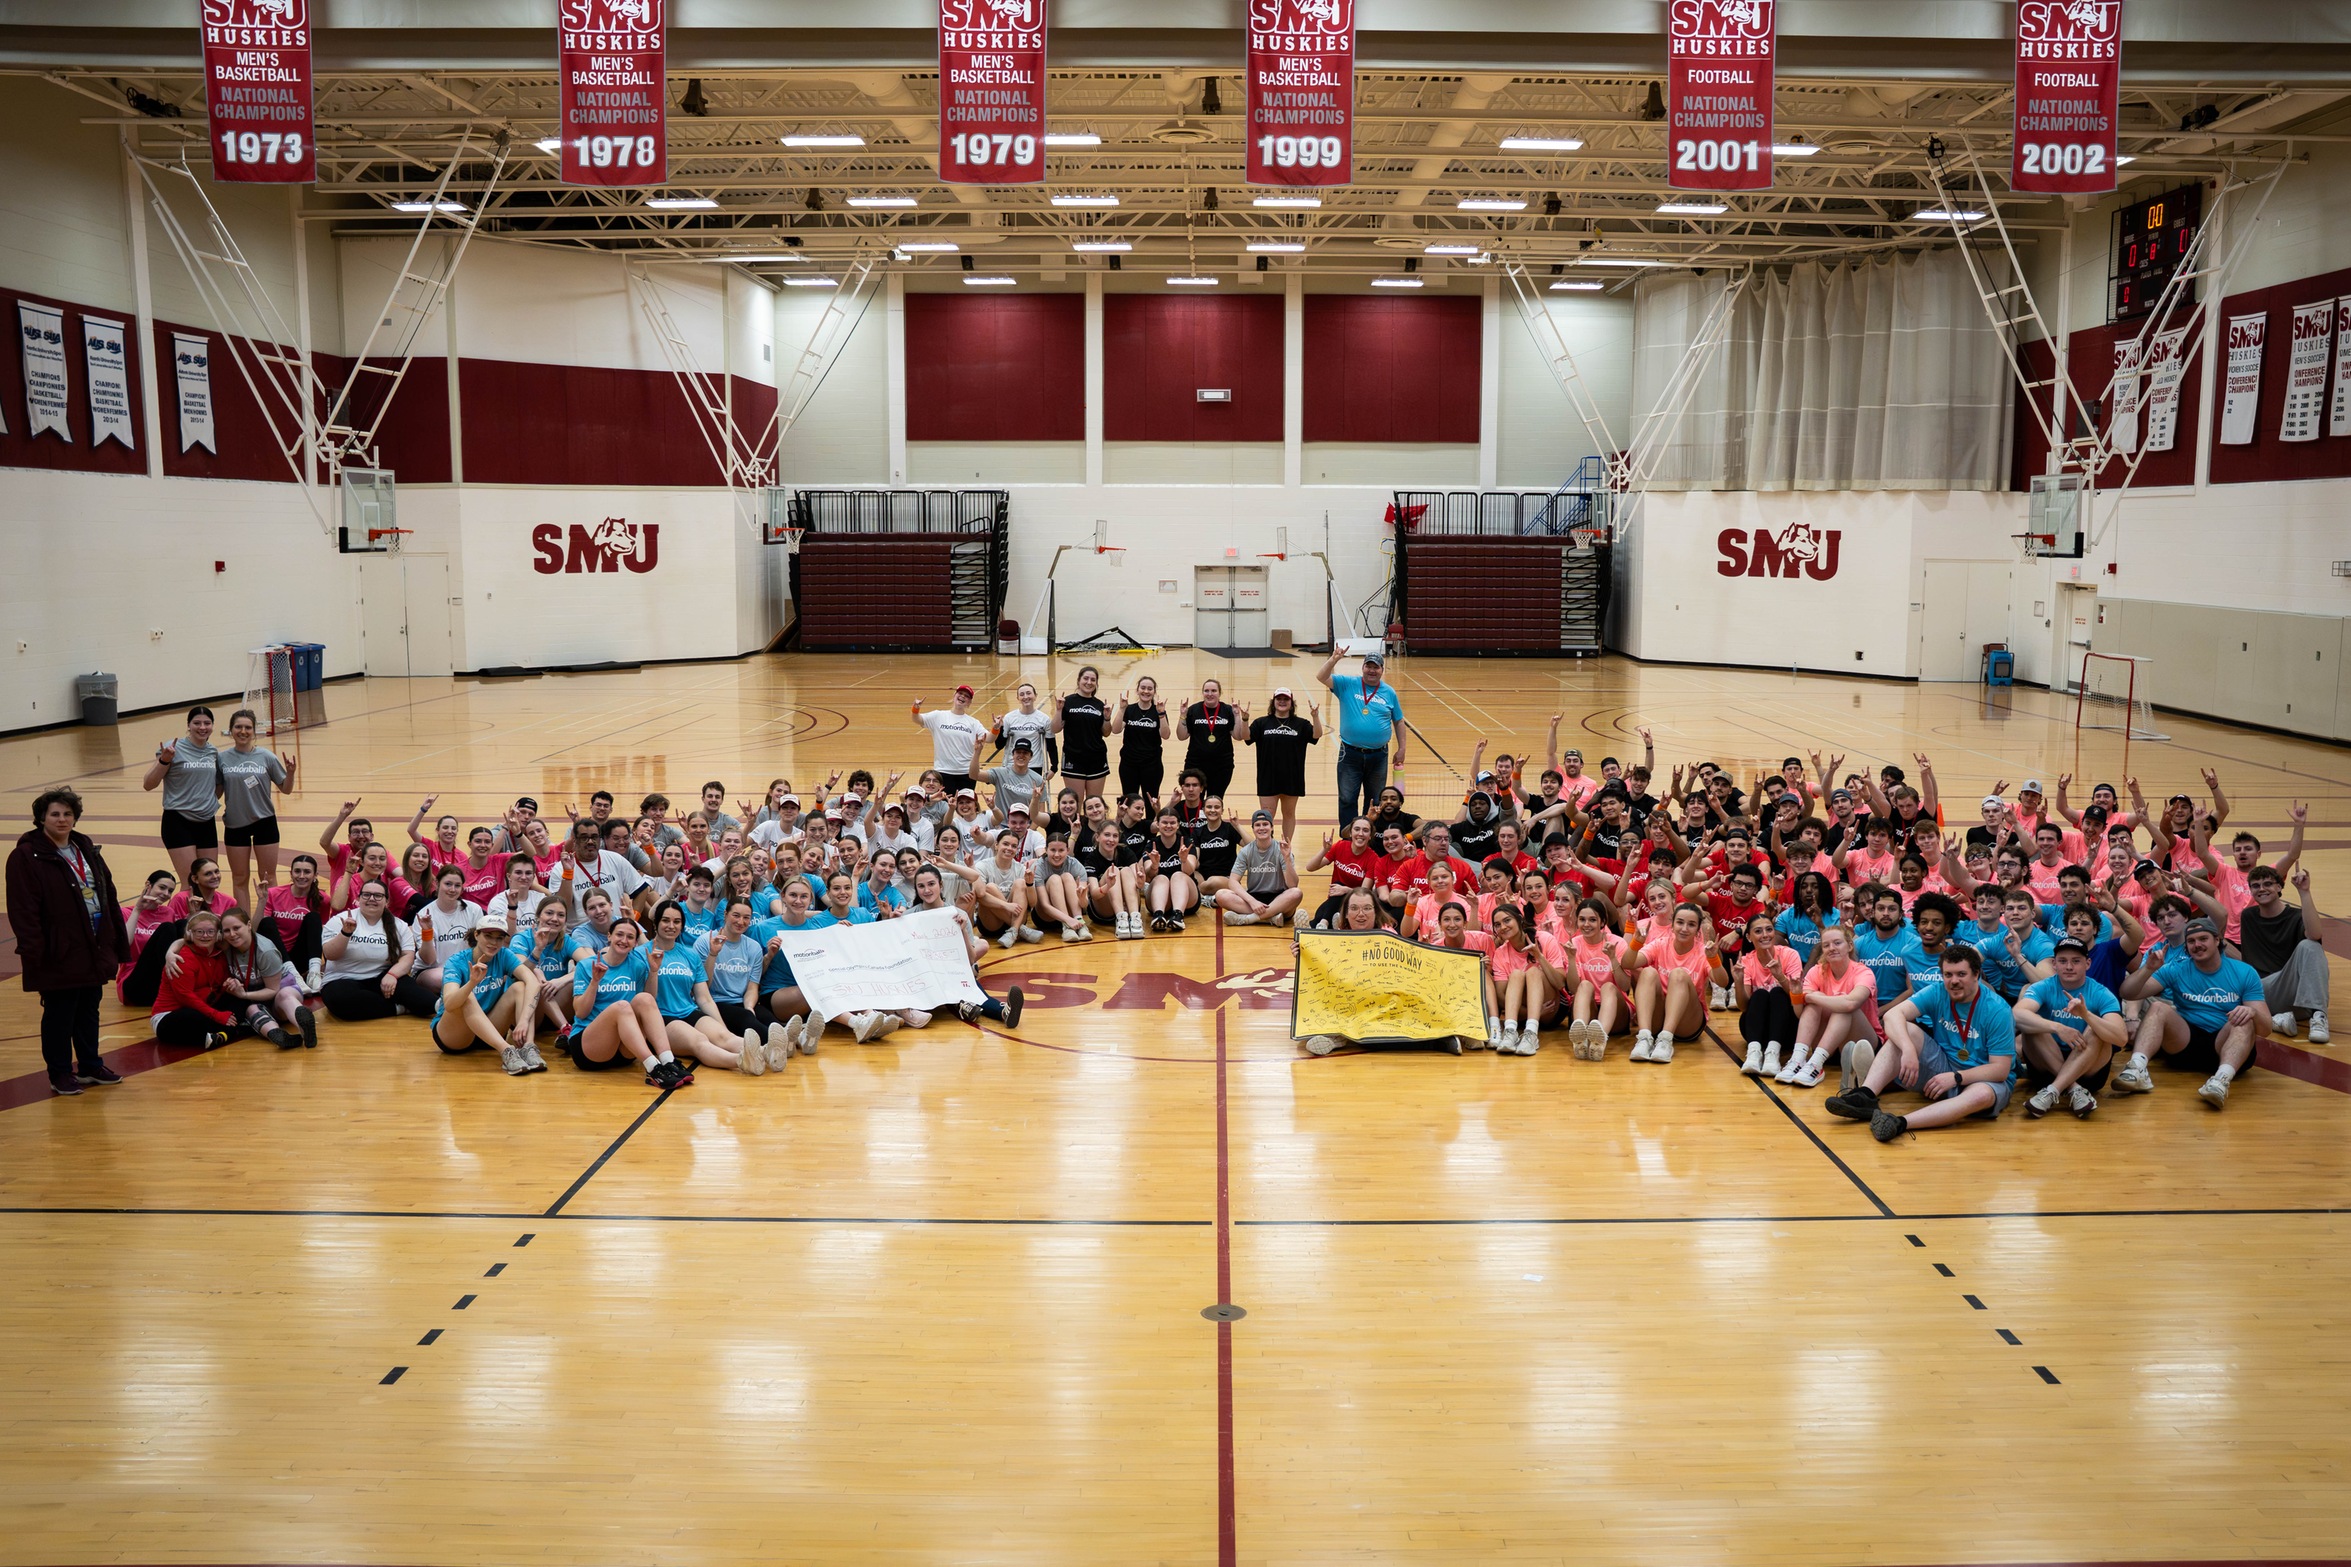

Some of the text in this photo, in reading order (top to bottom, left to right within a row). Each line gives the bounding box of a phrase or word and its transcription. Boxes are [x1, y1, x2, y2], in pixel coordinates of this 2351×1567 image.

[204, 0, 306, 29] SMU
[561, 0, 661, 33] SMU
[942, 0, 1043, 31] SMU
[1250, 0, 1352, 34] SMU
[1671, 0, 1772, 39] SMU
[2019, 0, 2119, 41] SMU
[207, 28, 307, 46] HUSKIES
[564, 33, 661, 50] HUSKIES
[944, 31, 1042, 49] HUSKIES
[1252, 34, 1350, 52] HUSKIES
[1673, 38, 1770, 56] HUSKIES
[2020, 41, 2115, 59] HUSKIES
[236, 52, 280, 66] MEN'S
[590, 56, 634, 71] MEN'S
[970, 54, 1014, 69] MEN'S
[1279, 56, 1322, 72] MEN'S
[215, 66, 302, 82] BASKETBALL
[572, 70, 655, 86] BASKETBALL
[950, 68, 1035, 84] BASKETBALL
[1259, 71, 1341, 87] BASKETBALL
[1688, 69, 1754, 84] FOOTBALL
[2034, 72, 2099, 87] FOOTBALL
[220, 87, 298, 104] NATIONAL
[577, 91, 652, 107] NATIONAL
[954, 89, 1031, 105] NATIONAL
[1262, 92, 1337, 108] NATIONAL
[1683, 95, 1757, 111] NATIONAL
[214, 103, 306, 121] CHAMPIONS
[569, 106, 658, 124] CHAMPIONS
[947, 105, 1038, 123] CHAMPIONS
[2028, 98, 2101, 114] NATIONAL
[1254, 107, 1345, 125] CHAMPIONS
[1675, 111, 1765, 129] CHAMPIONS
[2020, 114, 2108, 132] CHAMPIONS
[221, 130, 304, 165] 1973
[574, 134, 656, 168] 1978
[950, 132, 1036, 166] 1979
[1257, 135, 1342, 168] 1999
[1676, 139, 1760, 172] 2001
[2022, 143, 2107, 175] 2002
[2294, 310, 2332, 340] SMU
[2229, 322, 2264, 349] SMU
[2245, 363, 2259, 372] SOCCE
[2294, 366, 2325, 378] ONFERENCE
[532, 523, 659, 574] SMU
[1717, 528, 1841, 581] SMU
[183, 760, 216, 769] motionba
[1200, 839, 1229, 849] otionball
[273, 910, 305, 921] motionb
[884, 957, 912, 970] Foundation
[1362, 946, 1422, 970] #NO GOOD WAY
[870, 978, 926, 996] HUSKIES
[979, 970, 1294, 1011] SM
[2182, 991, 2240, 1004] motionball
